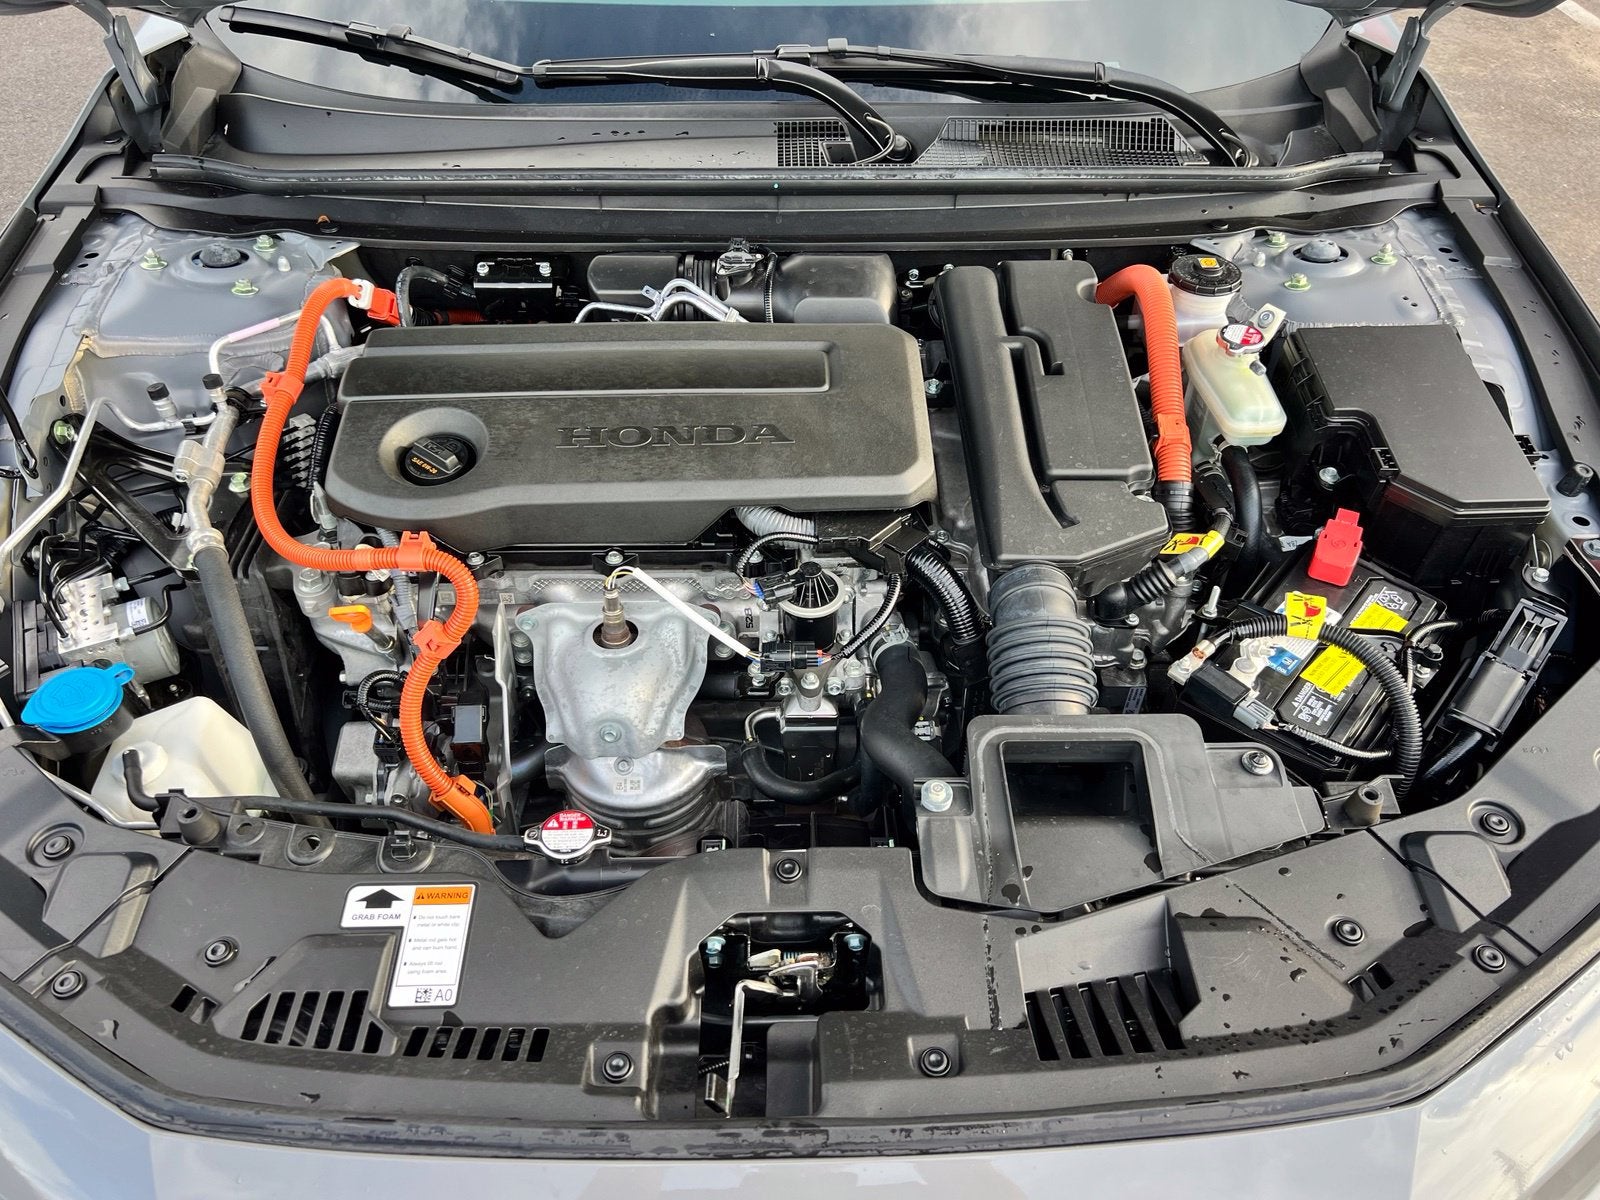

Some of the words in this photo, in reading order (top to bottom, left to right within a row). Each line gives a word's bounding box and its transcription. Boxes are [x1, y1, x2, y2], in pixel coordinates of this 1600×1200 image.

[555, 422, 796, 449] HONDA
[744, 608, 754, 628] 528
[426, 891, 469, 900] WARNING
[351, 913, 375, 921] GRAB
[434, 988, 453, 1002] A0
